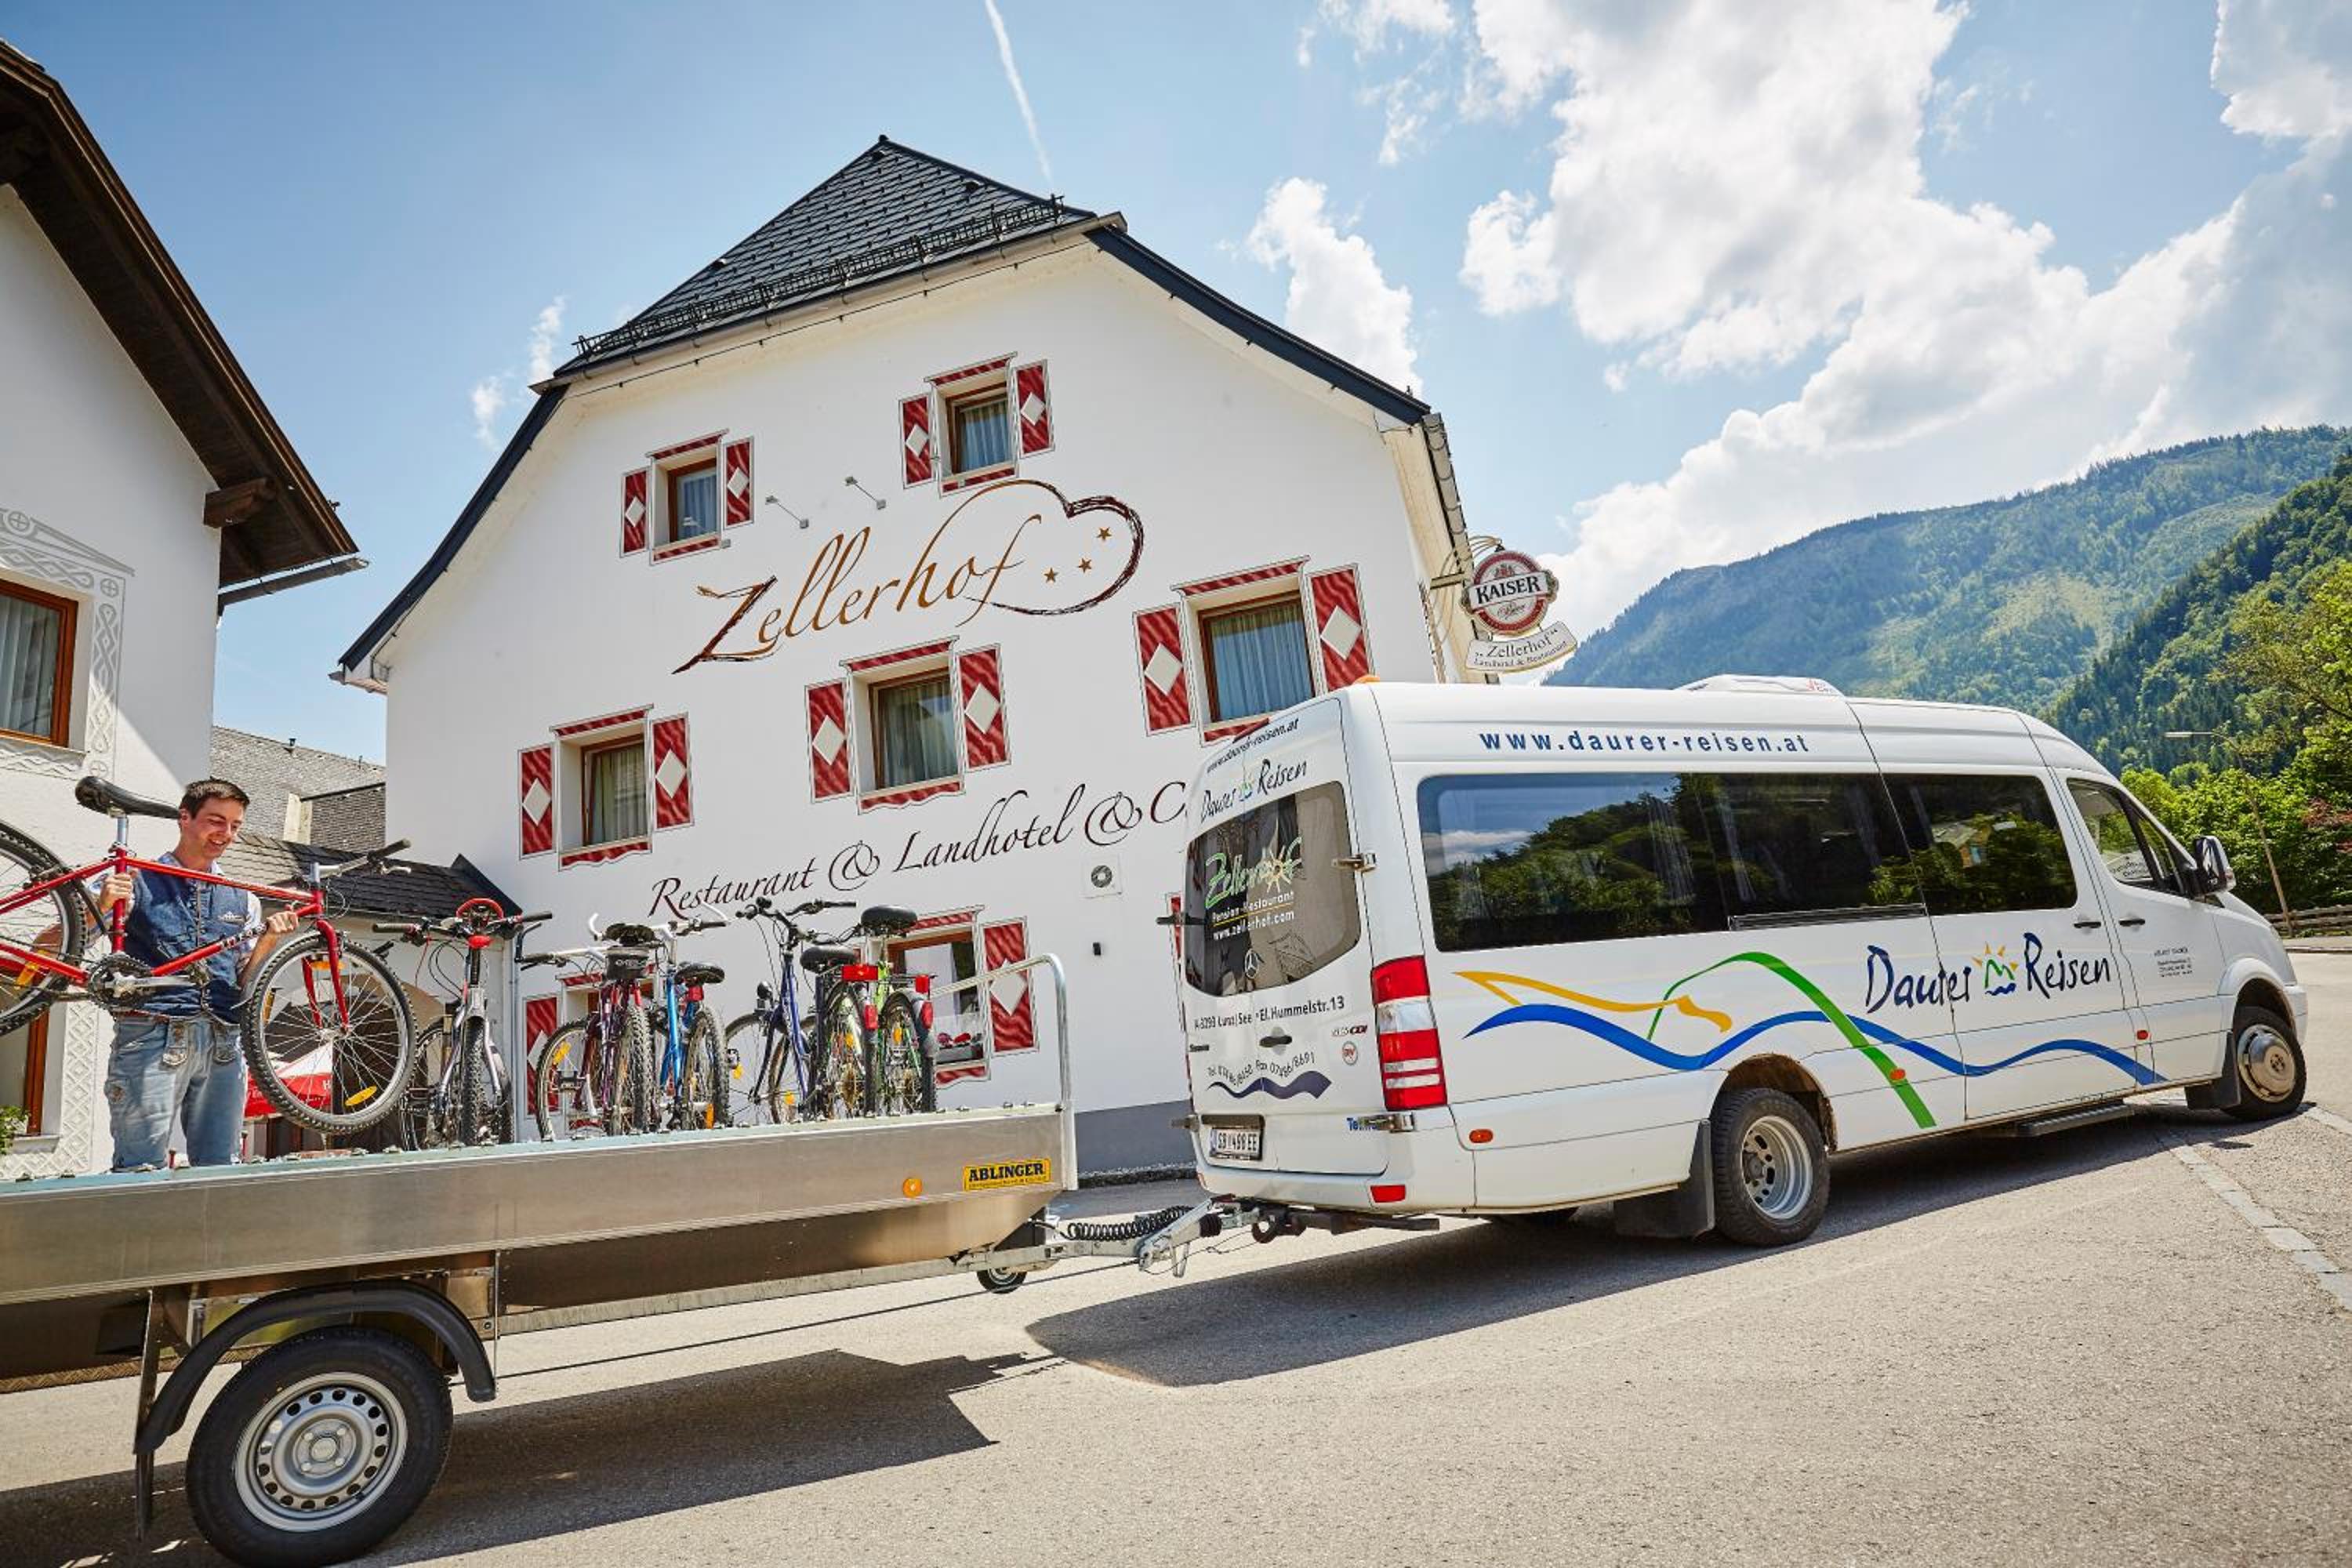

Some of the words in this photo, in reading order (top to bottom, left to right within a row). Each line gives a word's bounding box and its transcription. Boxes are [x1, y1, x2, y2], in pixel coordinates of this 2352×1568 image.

[673, 479, 1042, 675] Zellerhof
[1475, 576, 1541, 604] KAISER
[1479, 730, 1809, 753] www.daurer-reisen.at
[1258, 758, 1308, 796] Reisen
[648, 858, 819, 921] Restaurant
[892, 783, 1087, 873] Landhotel
[1865, 944, 1972, 1014] Daurer
[2023, 931, 2112, 999] Reisen
[969, 1163, 1044, 1181] ABLINGER
